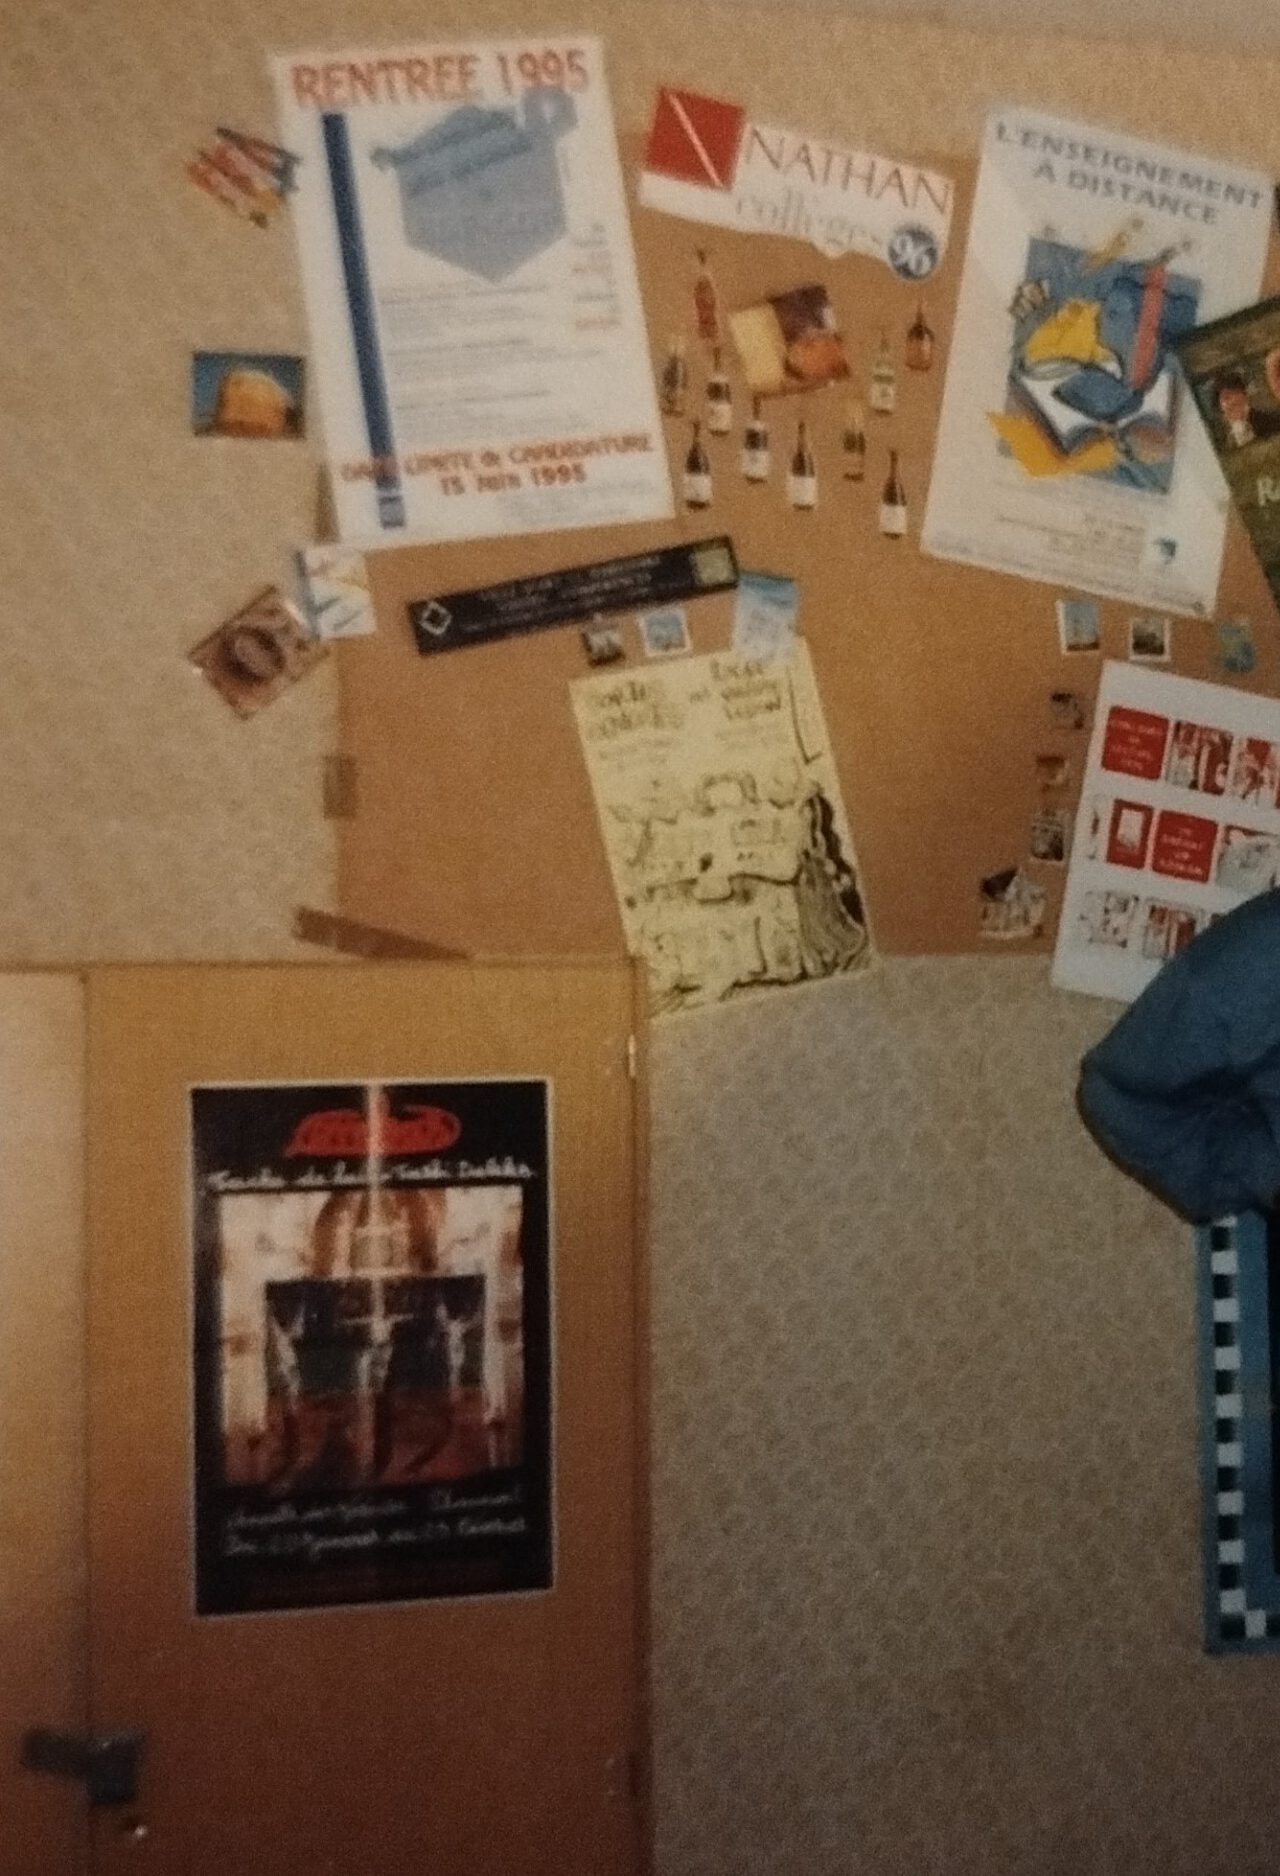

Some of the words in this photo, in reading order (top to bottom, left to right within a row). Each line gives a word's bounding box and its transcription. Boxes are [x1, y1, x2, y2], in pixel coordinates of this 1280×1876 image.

[293, 54, 479, 104] RENTREE
[498, 49, 588, 97] 1995
[752, 126, 951, 217] NATHAN
[1067, 167, 1218, 226] DISTANCE
[530, 462, 588, 489] 1995
